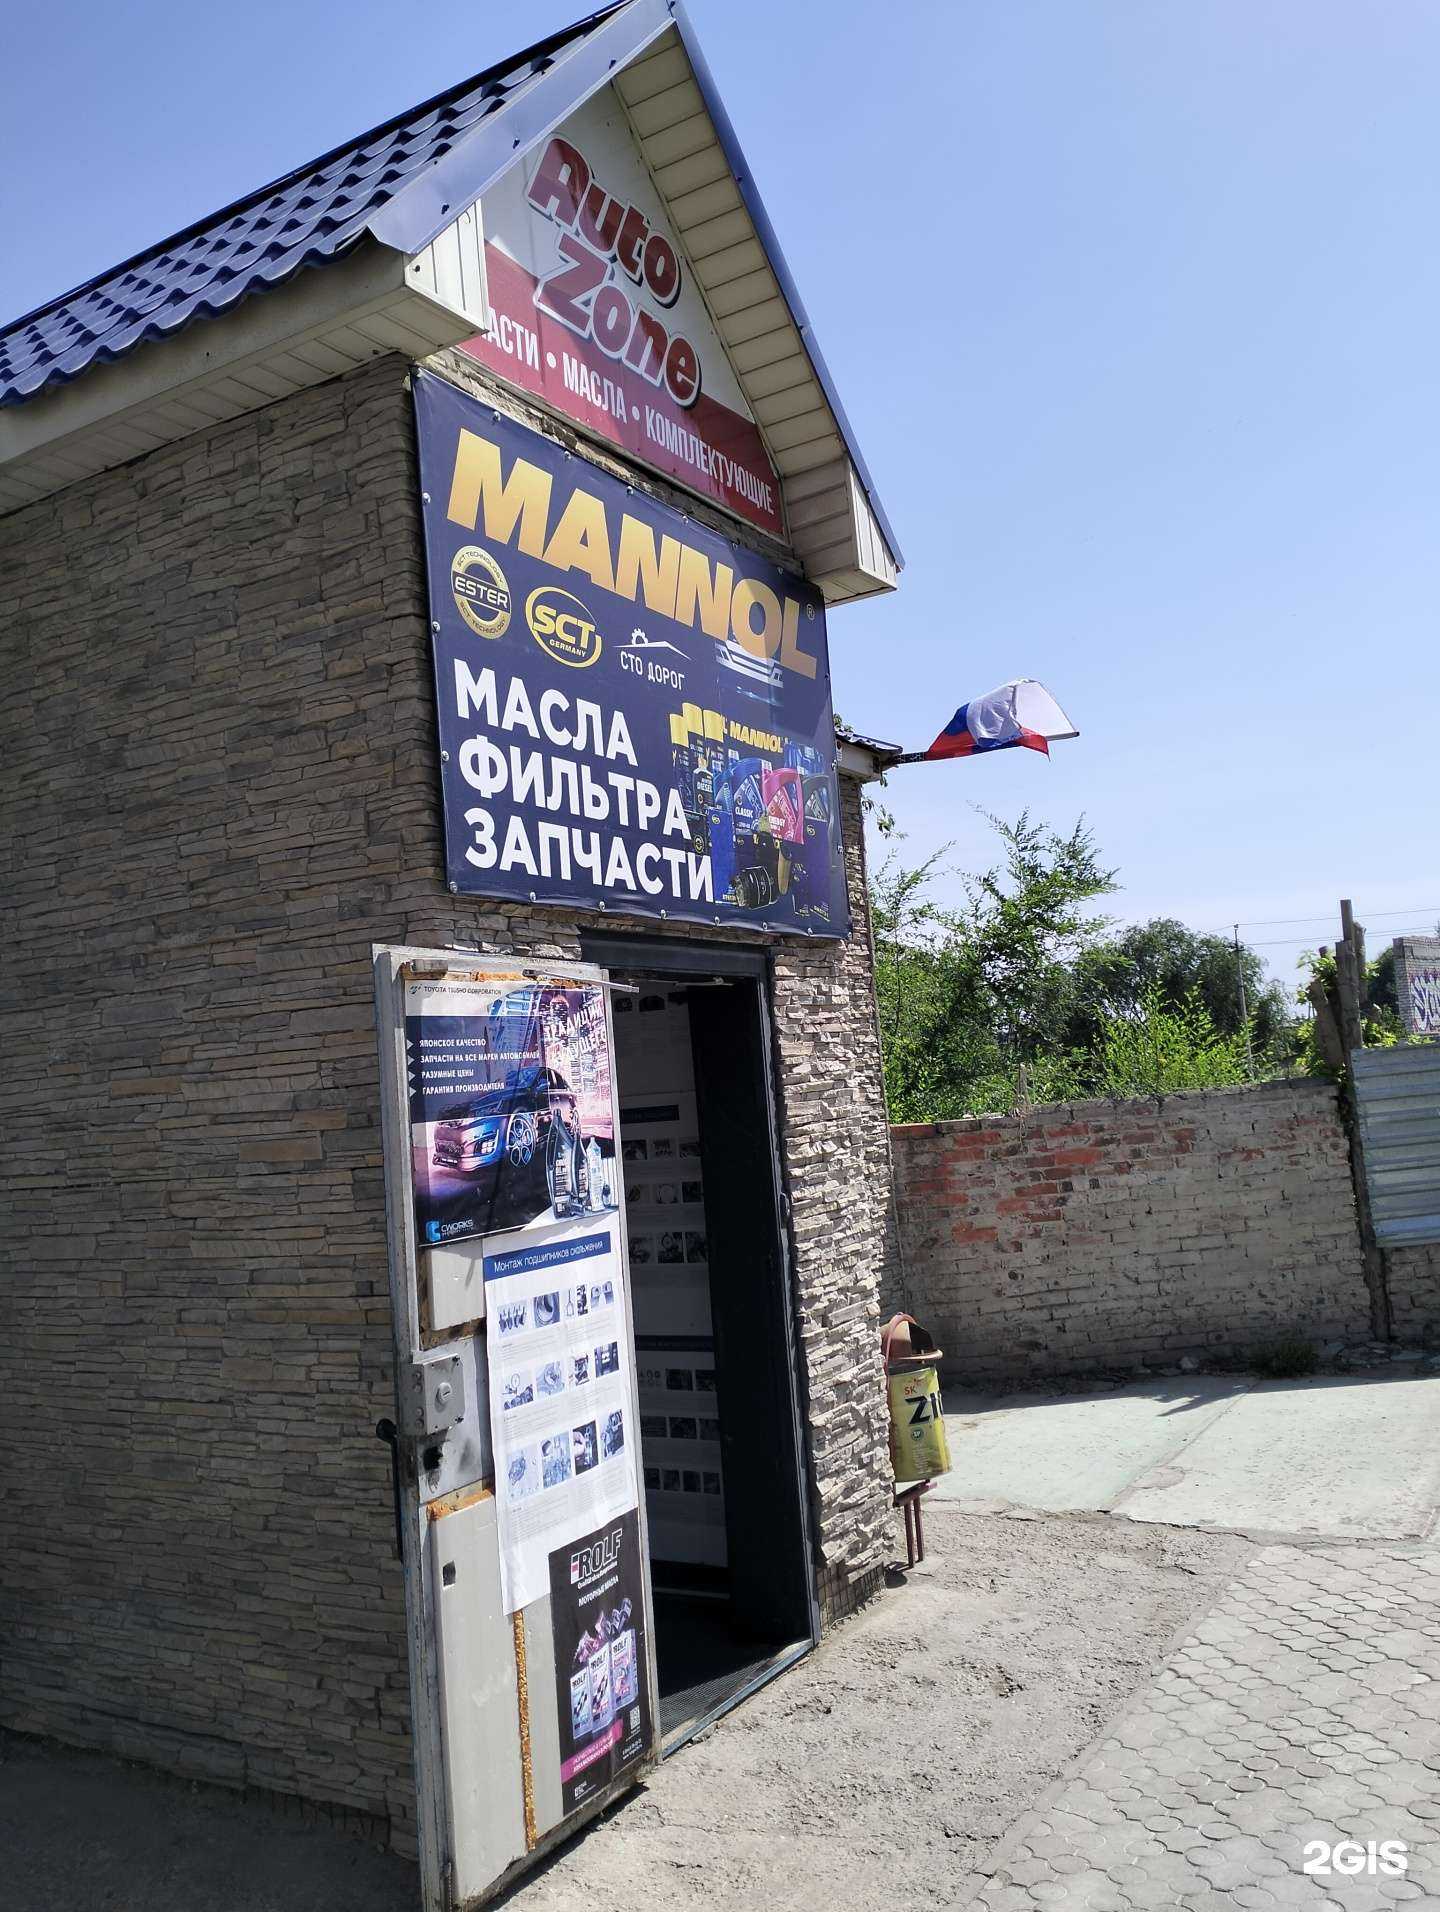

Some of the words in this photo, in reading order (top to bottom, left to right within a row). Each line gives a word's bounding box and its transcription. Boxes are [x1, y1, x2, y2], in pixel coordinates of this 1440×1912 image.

[526, 136, 682, 307] Auto
[533, 233, 702, 408] Zone
[481, 306, 540, 371] АСТИ
[562, 352, 628, 424] МАСЛА
[645, 405, 775, 515] КОМПЛЕКТУЮЩИЕ
[447, 428, 817, 680] MANNOL
[455, 576, 508, 609] ESTER
[533, 604, 596, 649] SCT
[549, 639, 586, 658] GERMANY
[620, 651, 643, 676] СТО
[648, 662, 685, 691] ДОРОГ
[453, 658, 638, 767] МАСЛА
[729, 720, 783, 754] MANNOL
[458, 734, 692, 840] ФИЛЬТРА
[464, 807, 714, 903] ЗАПЧАСТИ
[419, 1039, 455, 1048] ЯПОНСКОЕ
[456, 1038, 487, 1047] КАЧЕСТВО
[420, 1054, 454, 1064] ЗАПЧАСТИ
[455, 1054, 464, 1062] НА
[465, 1054, 478, 1062] ВСЕ
[478, 1053, 498, 1062] МАРКИ
[421, 1070, 456, 1080] РАЗУМНЫЕ
[457, 1069, 474, 1079] ЦЕНЫ
[422, 1085, 454, 1095] ГАРАНТИЯ
[455, 1082, 505, 1093] ПРОИЗВОДИТЕЛЯ
[441, 1219, 474, 1233] CWORKS
[494, 1258, 522, 1273] Монтаж
[524, 1249, 569, 1266] подшипников
[570, 1241, 603, 1257] скольжения
[904, 1386, 917, 1396] SK
[905, 1391, 944, 1425] ZI
[577, 1528, 623, 1581] ROLF
